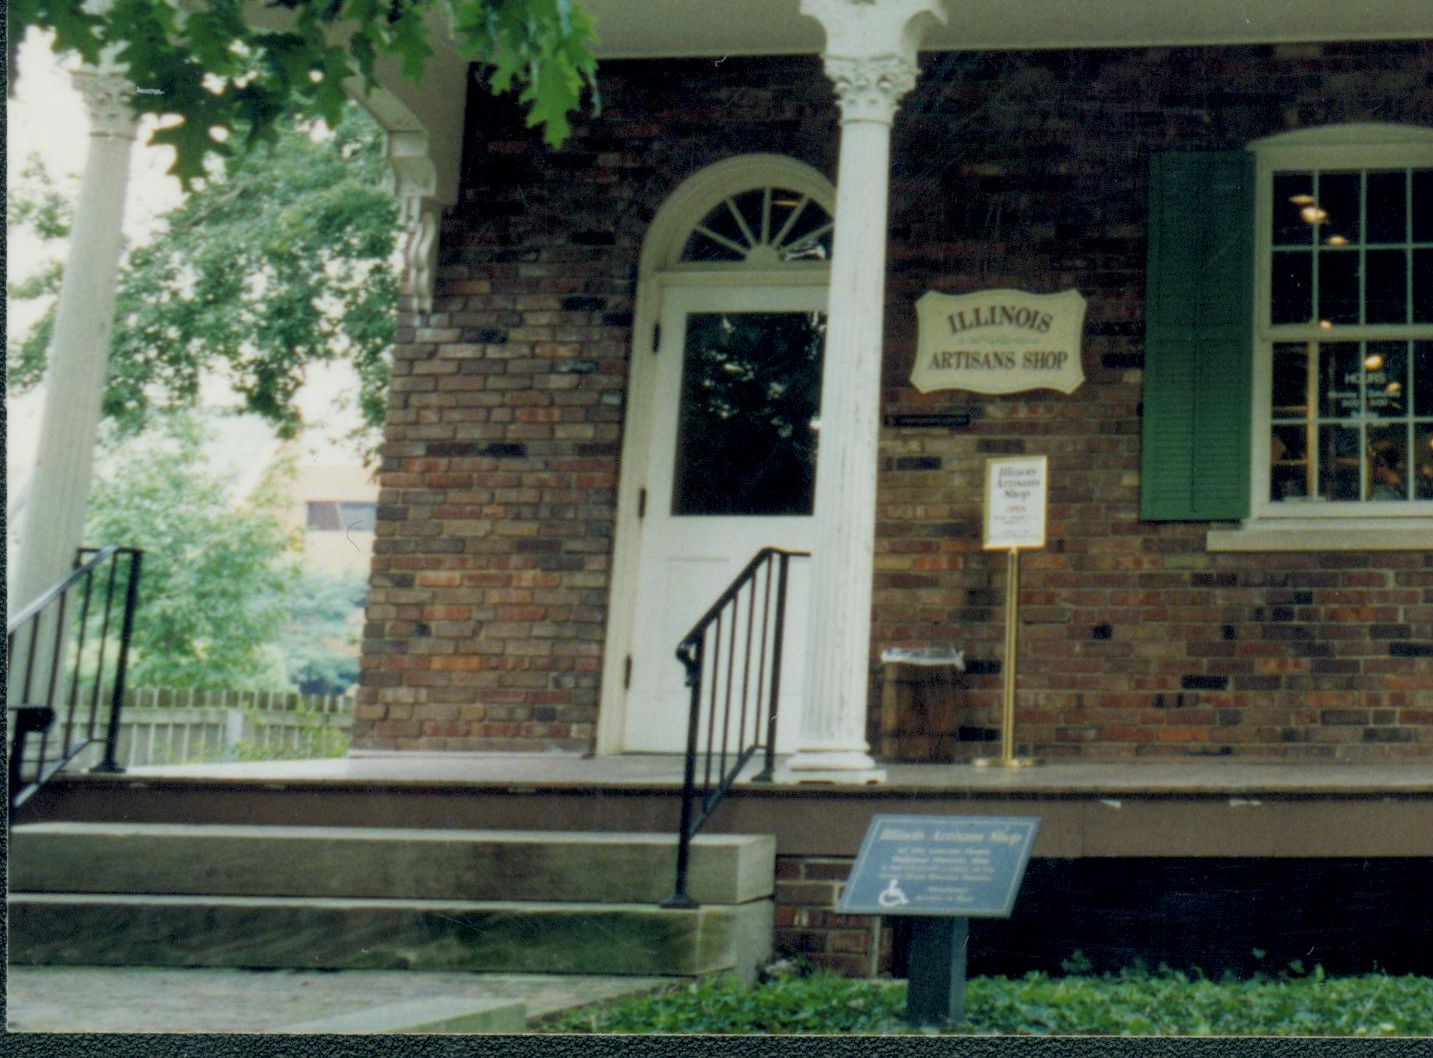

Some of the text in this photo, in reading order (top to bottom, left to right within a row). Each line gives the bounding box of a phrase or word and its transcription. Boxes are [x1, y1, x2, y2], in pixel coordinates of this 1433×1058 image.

[948, 305, 1054, 334] ILLINOIS
[929, 351, 1068, 370] ARTISANS SHOP
